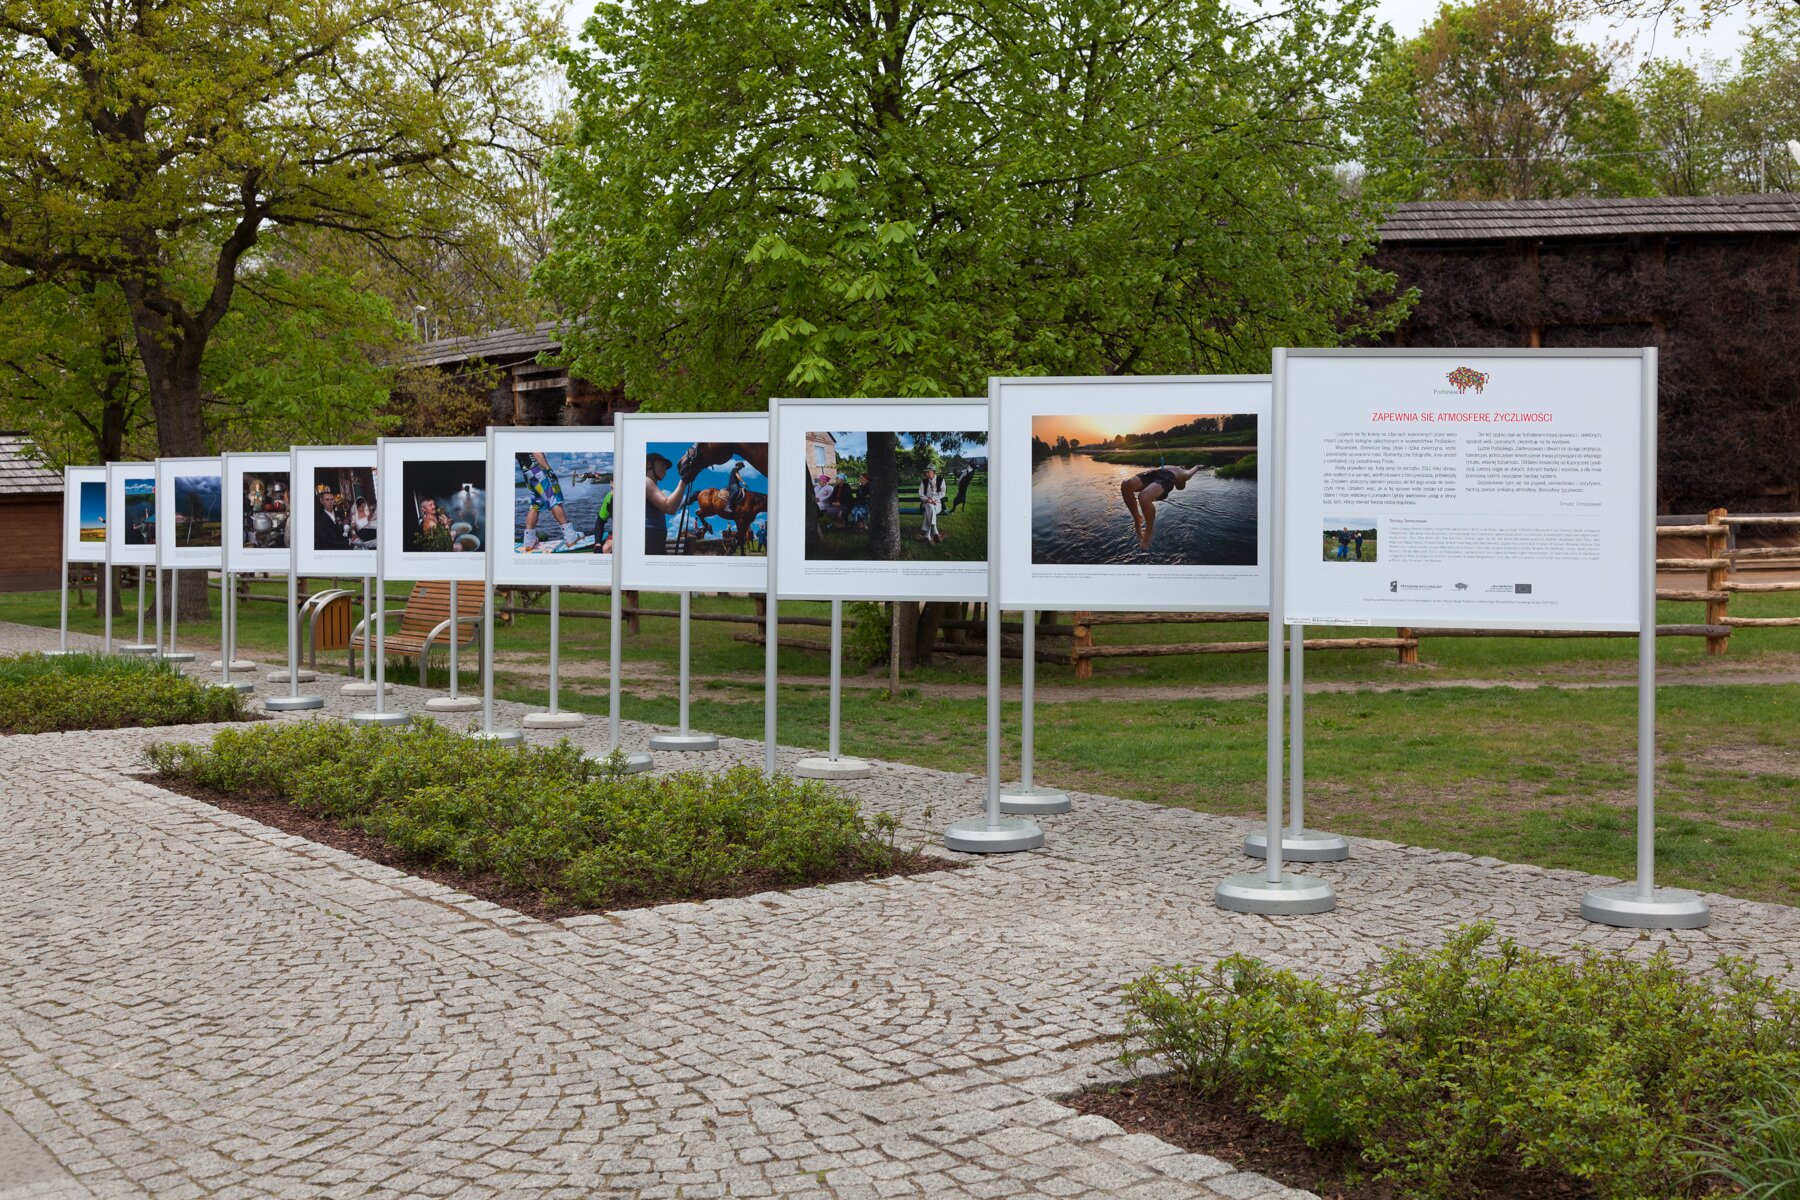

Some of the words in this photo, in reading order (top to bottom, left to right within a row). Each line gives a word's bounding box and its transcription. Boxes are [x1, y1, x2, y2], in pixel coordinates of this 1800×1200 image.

[1372, 412, 1418, 422] ZAPEWNIA
[1420, 412, 1434, 423] SIĘ
[1437, 412, 1490, 423] ATMOSFERĘ
[1494, 411, 1552, 422] ŻYCZLIWOŚCI
